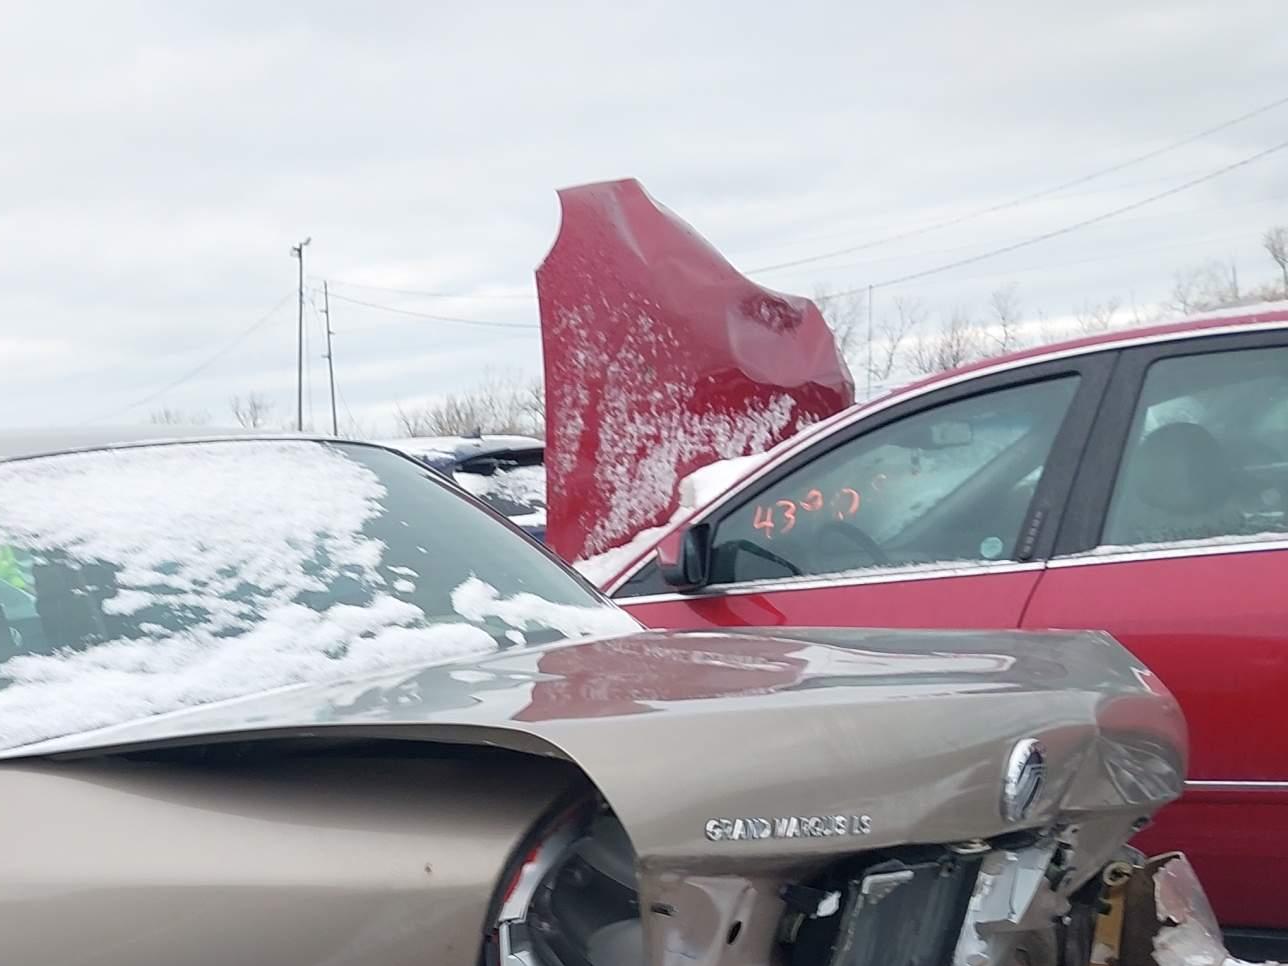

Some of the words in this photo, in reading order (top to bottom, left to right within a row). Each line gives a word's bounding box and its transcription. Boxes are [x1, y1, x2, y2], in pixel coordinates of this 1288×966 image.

[705, 818, 772, 841] GRAND
[774, 815, 848, 838] MARQUIS
[851, 815, 873, 835] LS
